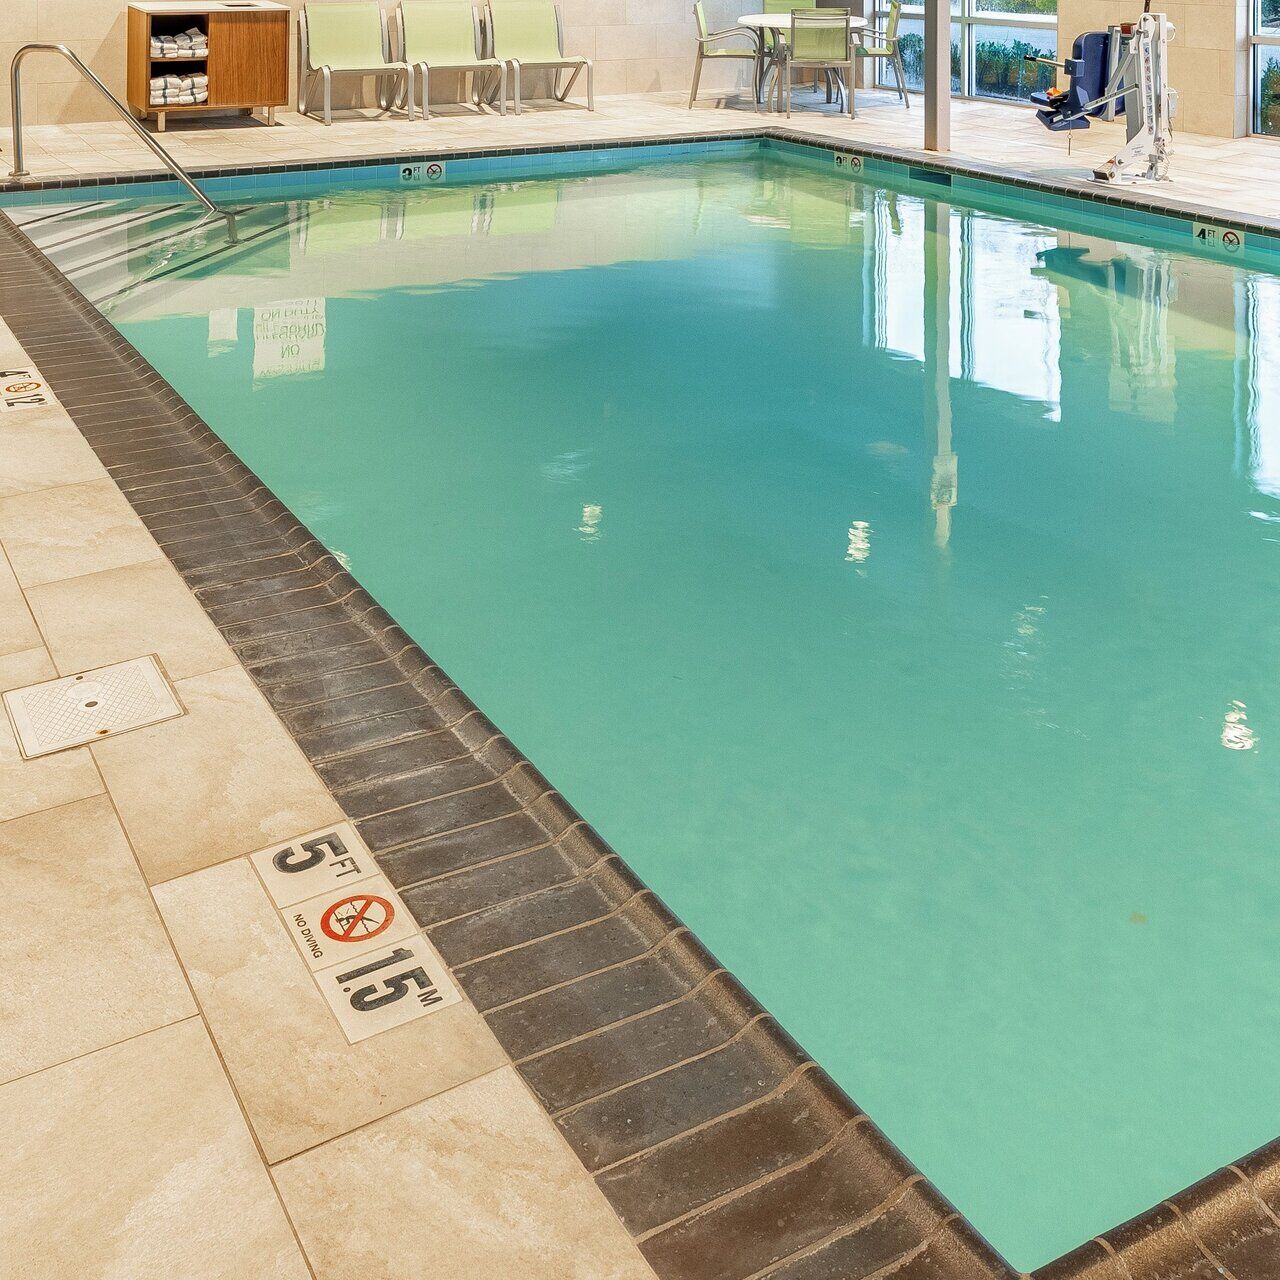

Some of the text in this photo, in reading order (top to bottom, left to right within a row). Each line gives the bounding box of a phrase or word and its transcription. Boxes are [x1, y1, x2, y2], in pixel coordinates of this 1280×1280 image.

[1207, 229, 1216, 239] FT
[272, 831, 363, 878] 5 FT
[292, 913, 324, 959] NO DIVING
[335, 947, 444, 1012] 1.5 M
